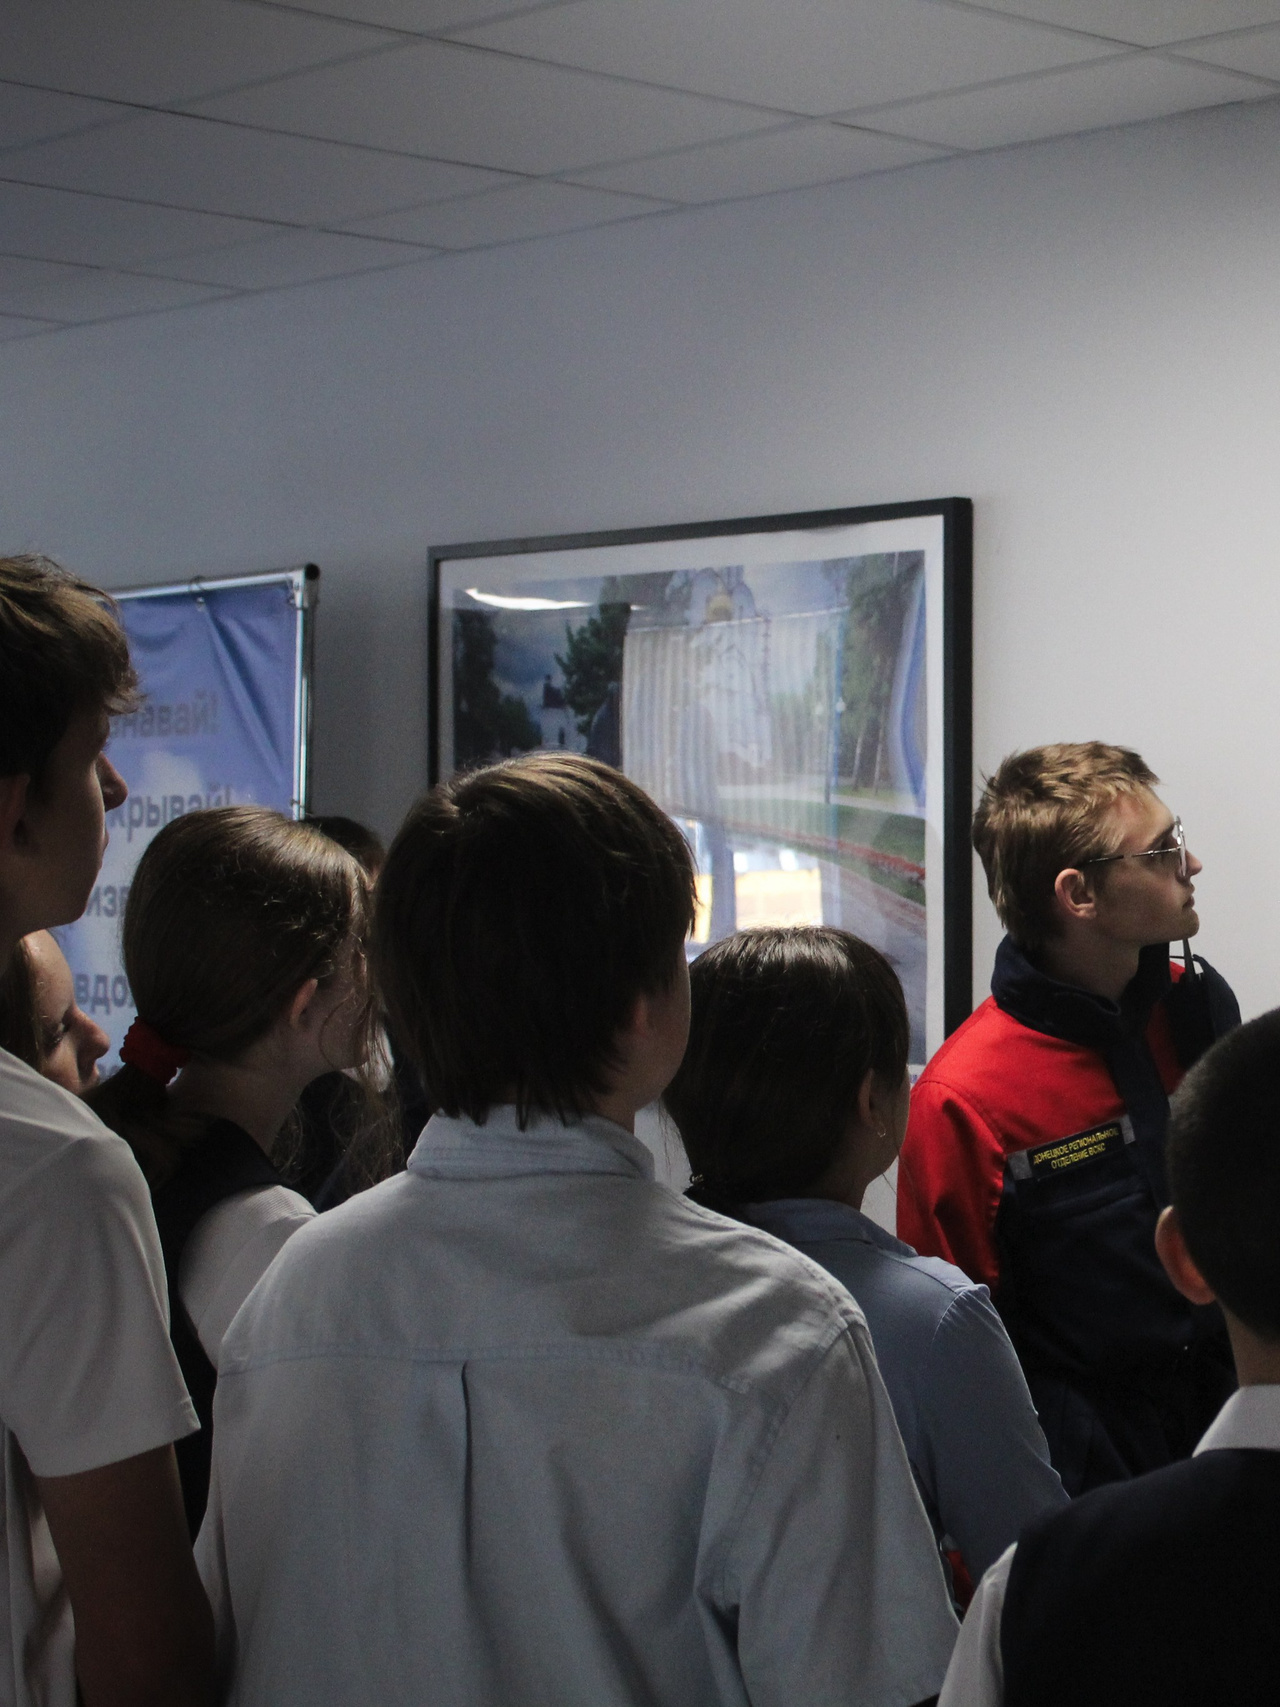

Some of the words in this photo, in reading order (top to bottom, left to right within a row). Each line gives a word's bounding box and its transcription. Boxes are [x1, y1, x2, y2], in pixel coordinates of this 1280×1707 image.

[1033, 1144, 1070, 1165] ДОНЕЦКОЕ
[1068, 1127, 1119, 1152] РЕГИОНАЛЬНОЕ
[1050, 1149, 1089, 1169] ОТДЕЛЕНИЕ
